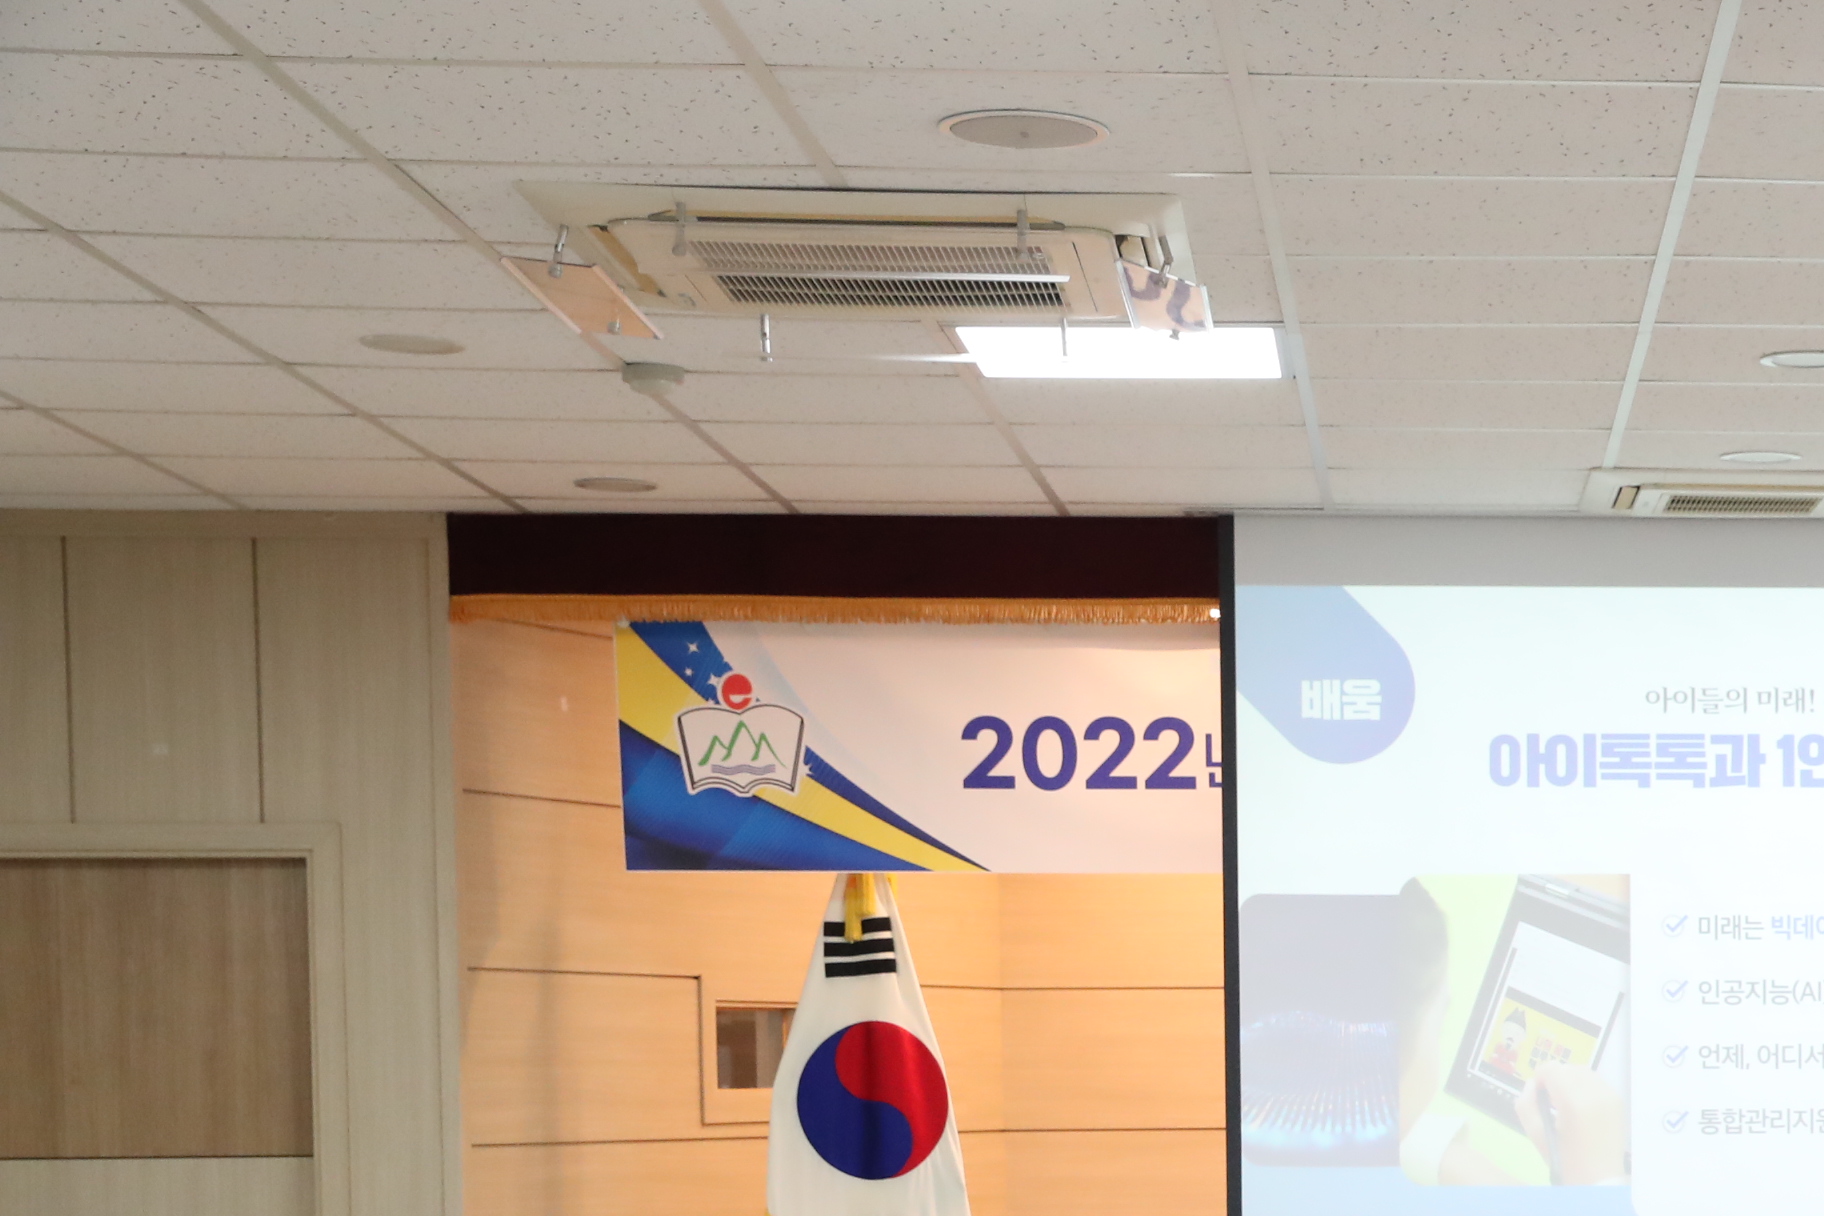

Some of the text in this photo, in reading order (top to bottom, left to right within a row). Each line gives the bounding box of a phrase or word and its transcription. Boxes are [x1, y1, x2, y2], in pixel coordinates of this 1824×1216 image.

[1301, 679, 1382, 720] 배움
[1645, 687, 1747, 714] 아이들의
[1757, 687, 1814, 713] 미래!
[1489, 733, 1766, 788] 아이톡톡과
[1698, 915, 1764, 940] 미래는
[1699, 1044, 1749, 1069] 언제,
